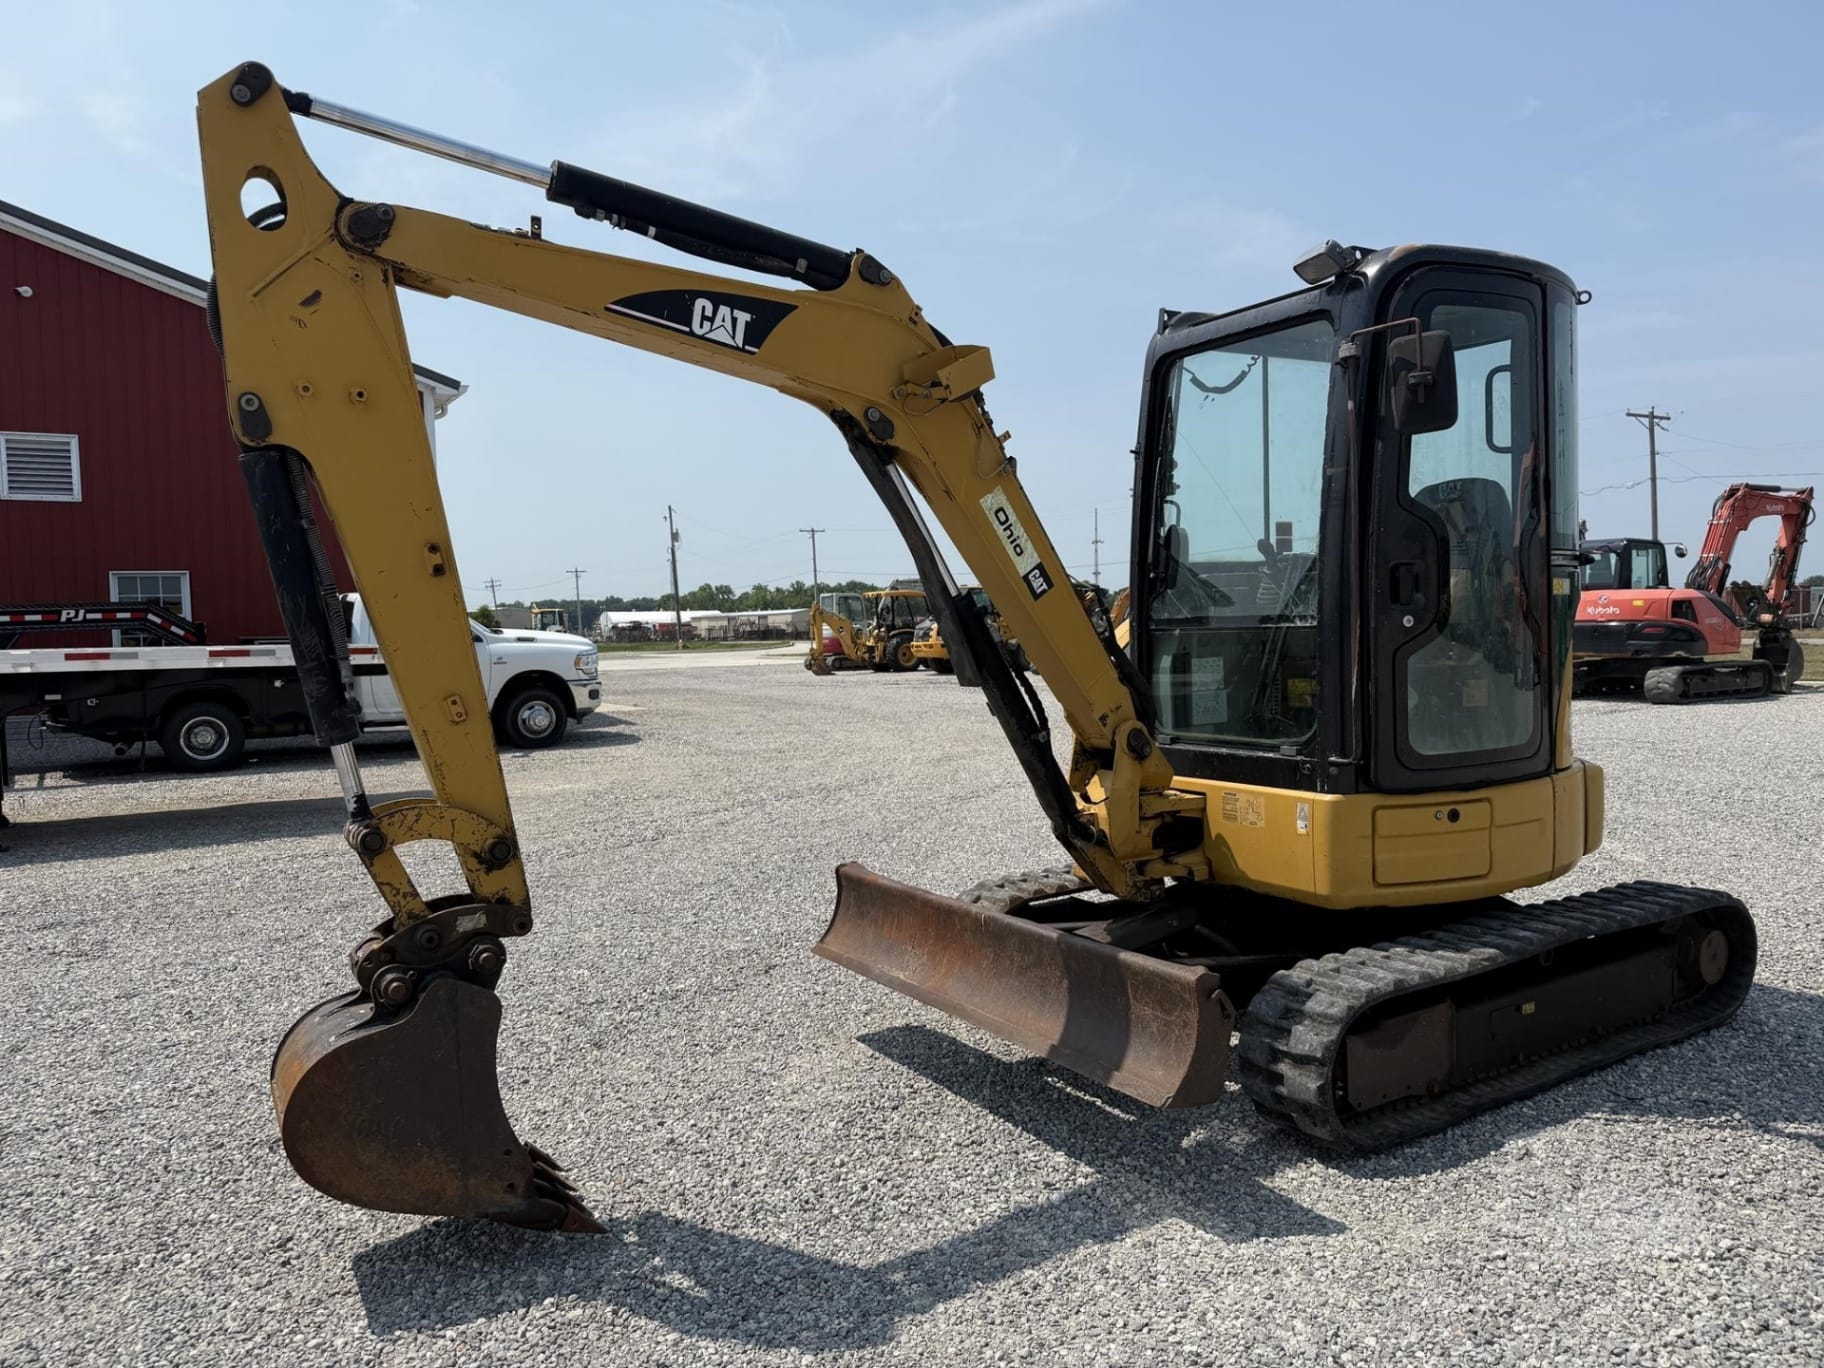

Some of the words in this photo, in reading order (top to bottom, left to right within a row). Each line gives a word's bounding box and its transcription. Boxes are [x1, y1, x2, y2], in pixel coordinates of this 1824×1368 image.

[692, 298, 751, 349] CAT
[994, 506, 1024, 557] Ohio
[1028, 569, 1048, 594] CAT
[60, 609, 85, 622] PJ
[1587, 606, 1620, 615] Kubota
